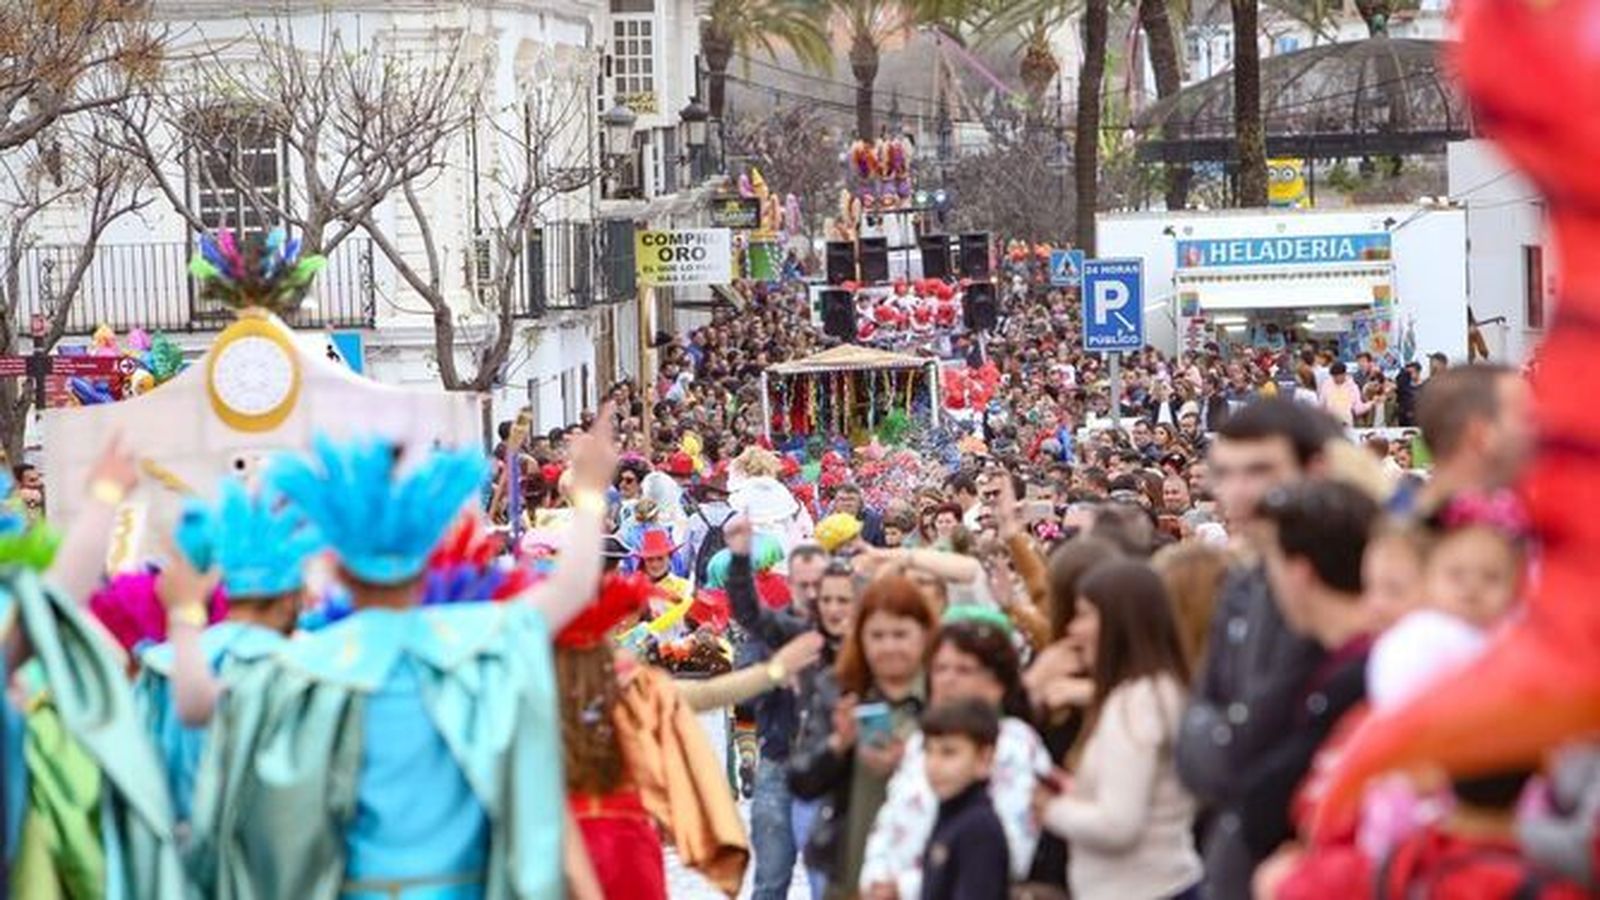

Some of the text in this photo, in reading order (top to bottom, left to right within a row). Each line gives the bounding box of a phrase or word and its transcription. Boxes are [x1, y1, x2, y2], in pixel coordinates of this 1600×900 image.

[658, 247, 706, 263] ORO
[1085, 265, 1138, 274] 24 HORAS
[1094, 280, 1130, 325] P
